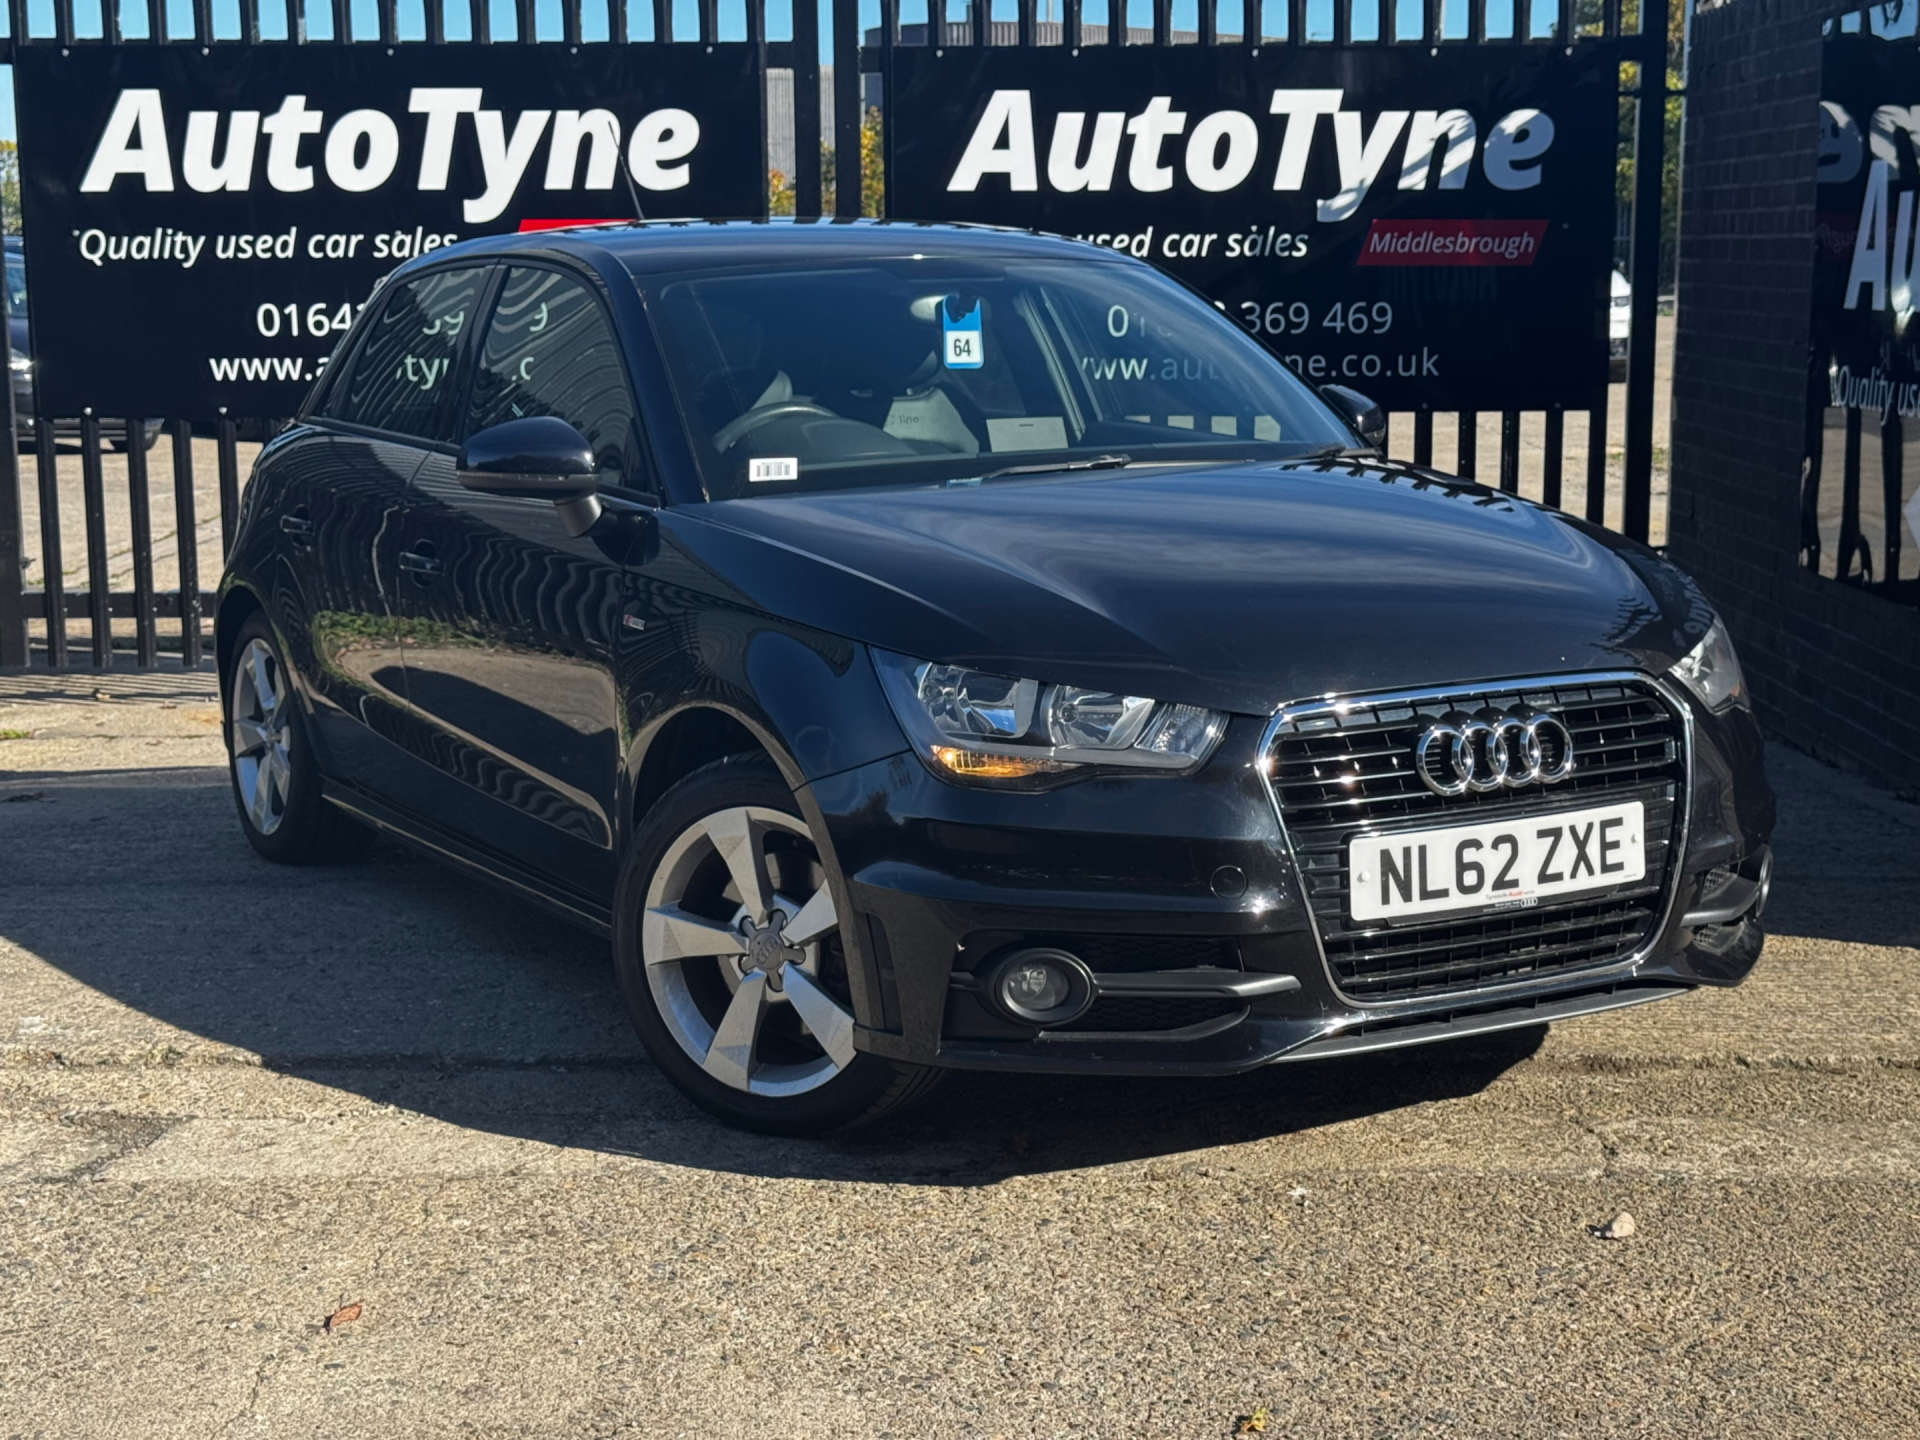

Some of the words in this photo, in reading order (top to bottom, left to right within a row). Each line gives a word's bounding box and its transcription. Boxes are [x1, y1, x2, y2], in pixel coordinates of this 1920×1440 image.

[79, 87, 700, 223] AutoTyne
[946, 88, 1556, 223] AutoTyne
[79, 228, 205, 268] Quality
[215, 227, 297, 259] used
[307, 232, 364, 258] car
[1162, 233, 1216, 258] car
[1225, 225, 1309, 258] sales
[1369, 230, 1535, 260] Middlesbrough
[1321, 301, 1393, 335] 469
[953, 337, 972, 357] 64
[1838, 364, 1895, 427] Quality
[1379, 832, 1519, 906] NL62
[1536, 816, 1625, 884] ZXE
